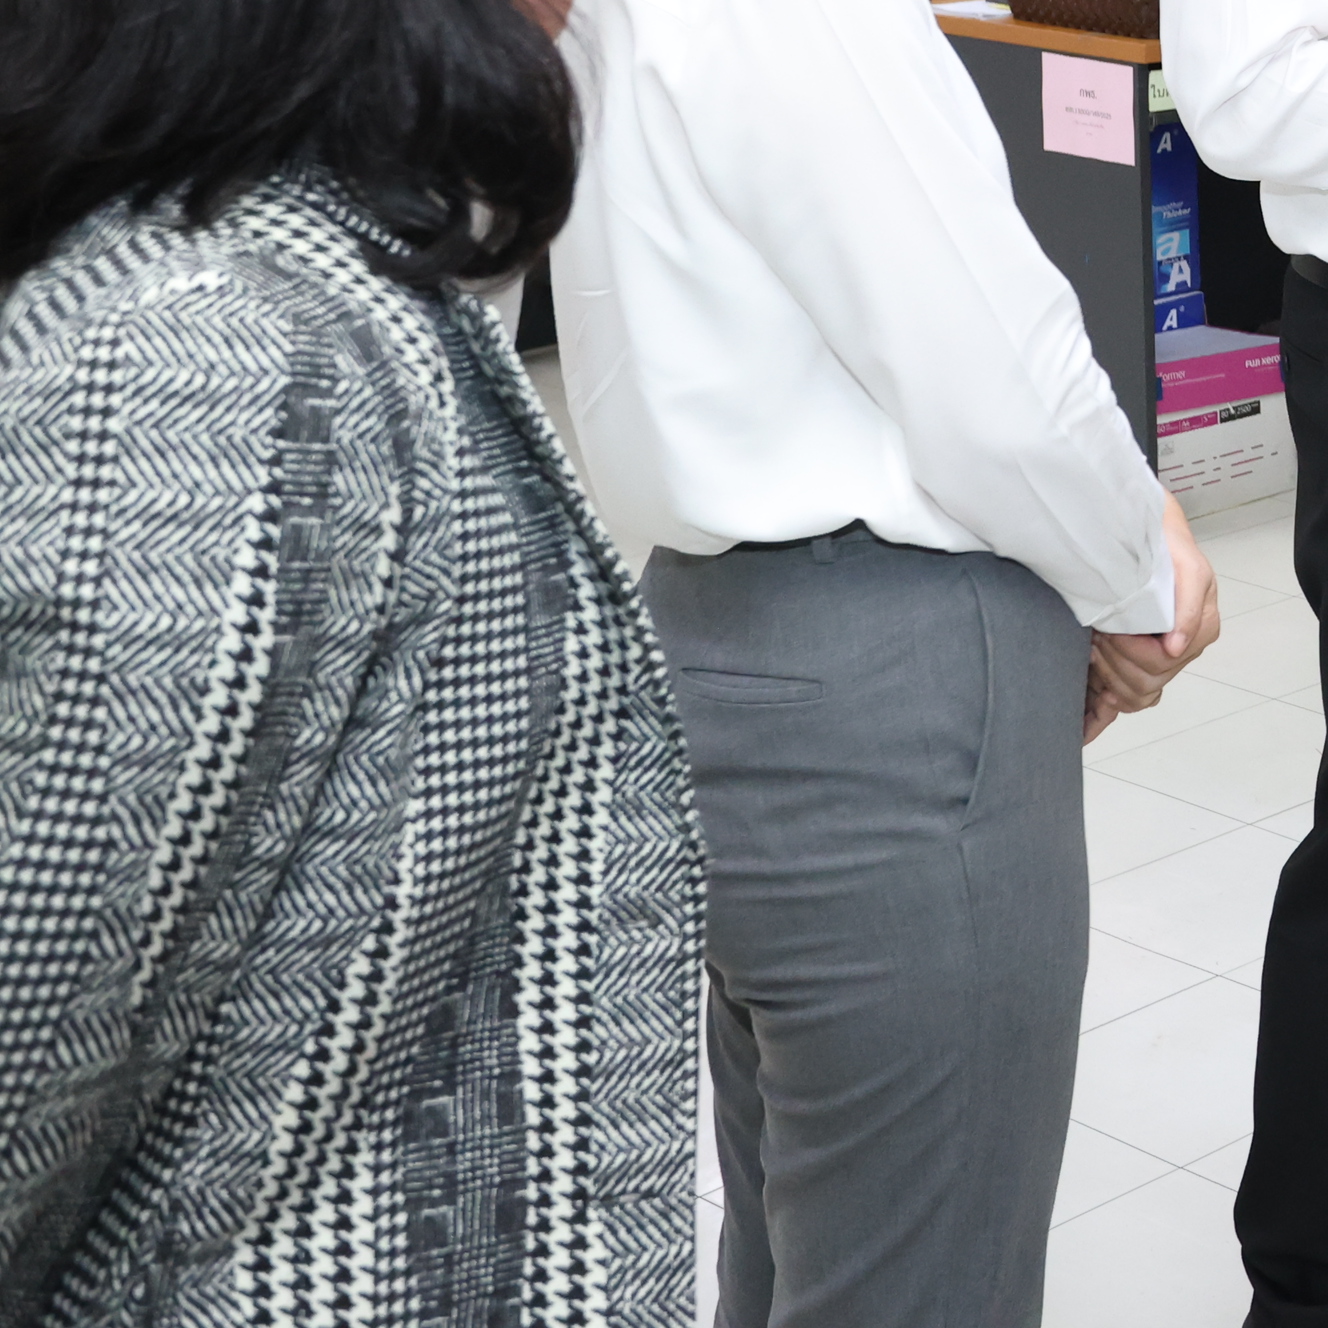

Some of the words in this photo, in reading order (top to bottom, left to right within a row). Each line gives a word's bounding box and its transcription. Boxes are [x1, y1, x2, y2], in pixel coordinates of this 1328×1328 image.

[1157, 131, 1172, 154] A
[1167, 260, 1192, 292] A
[1162, 308, 1178, 332] A
